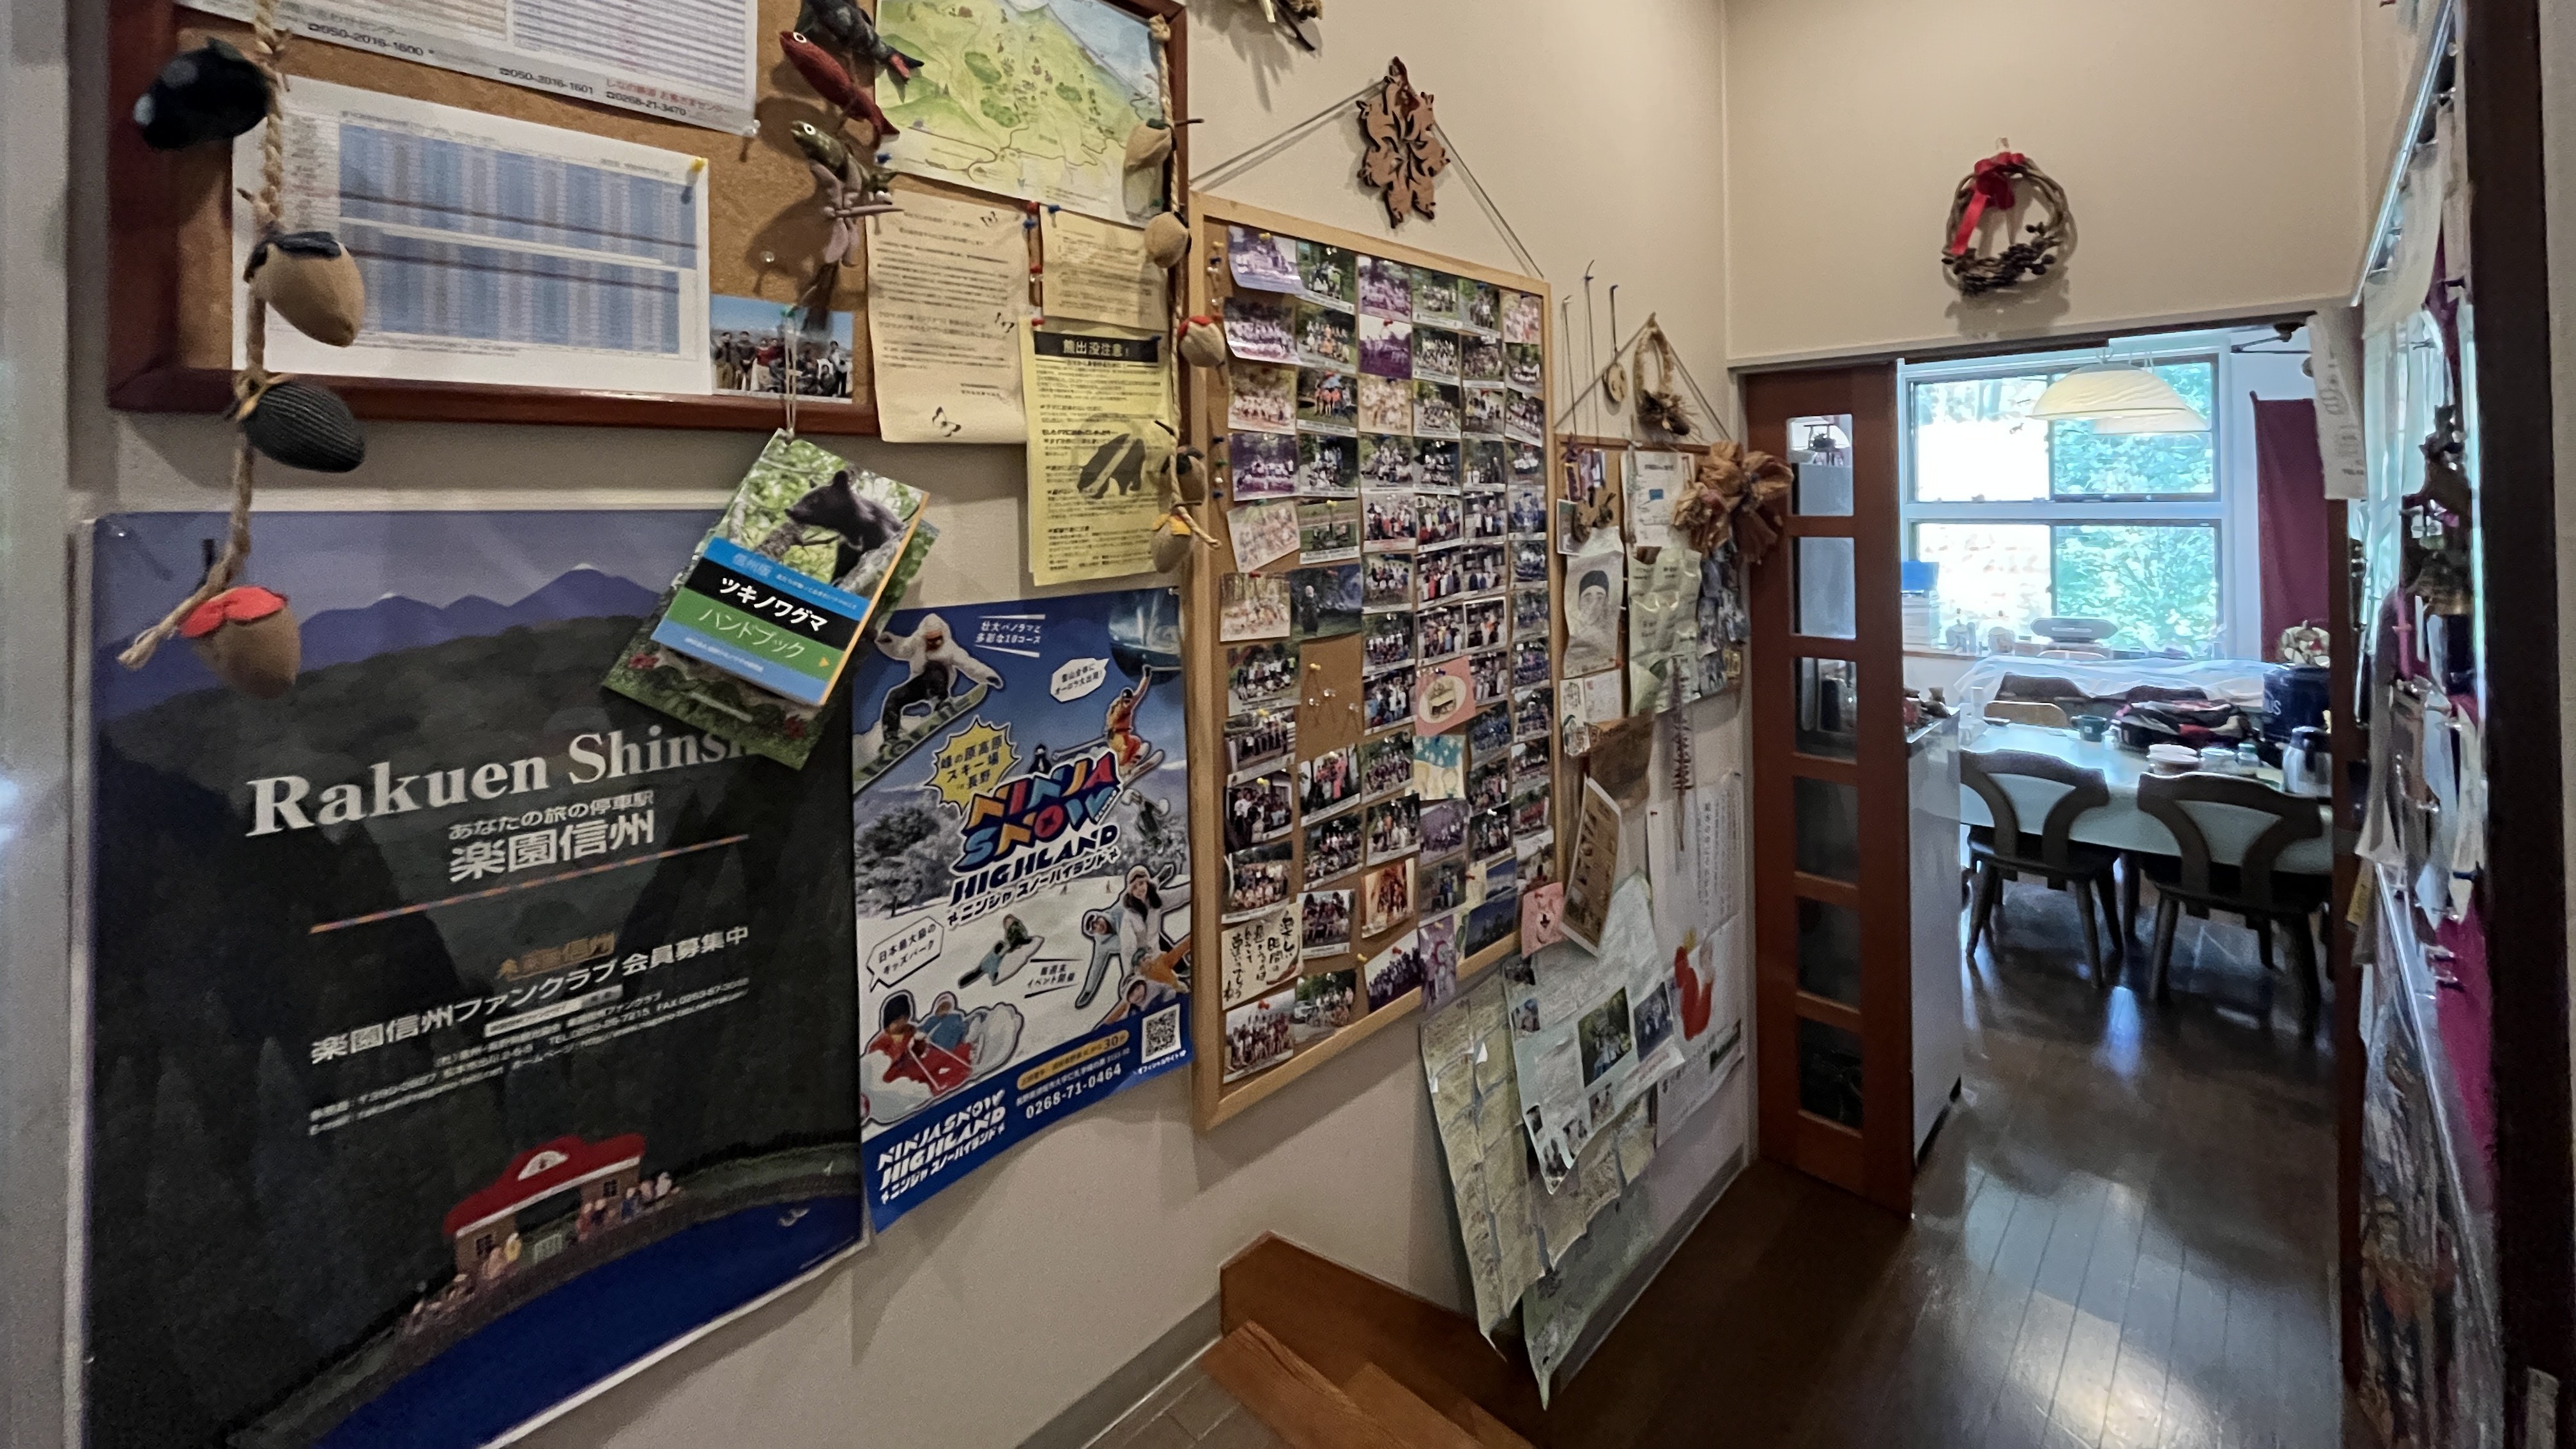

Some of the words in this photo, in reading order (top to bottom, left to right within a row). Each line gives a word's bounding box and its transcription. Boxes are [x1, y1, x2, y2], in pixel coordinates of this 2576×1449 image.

[698, 609, 805, 658] ハンドブック
[720, 577, 828, 632] ツキノワグマ
[981, 620, 1041, 633] 壮大パノラマと
[245, 751, 549, 838] Rakuen
[947, 751, 999, 783] スキー場
[962, 752, 1120, 832] NINJA
[448, 790, 654, 839] あなたの旅の停車駅
[449, 809, 654, 882] 楽園信州
[953, 785, 1120, 871] SNOW
[949, 825, 1118, 907] HIGHLAND
[961, 891, 1012, 921] ニンジャ
[1017, 855, 1107, 898] スノーハイランド
[879, 1106, 1006, 1191] HIGHLAND
[890, 1168, 929, 1200] ニンジャ
[930, 1127, 997, 1176] スノーハイランド
